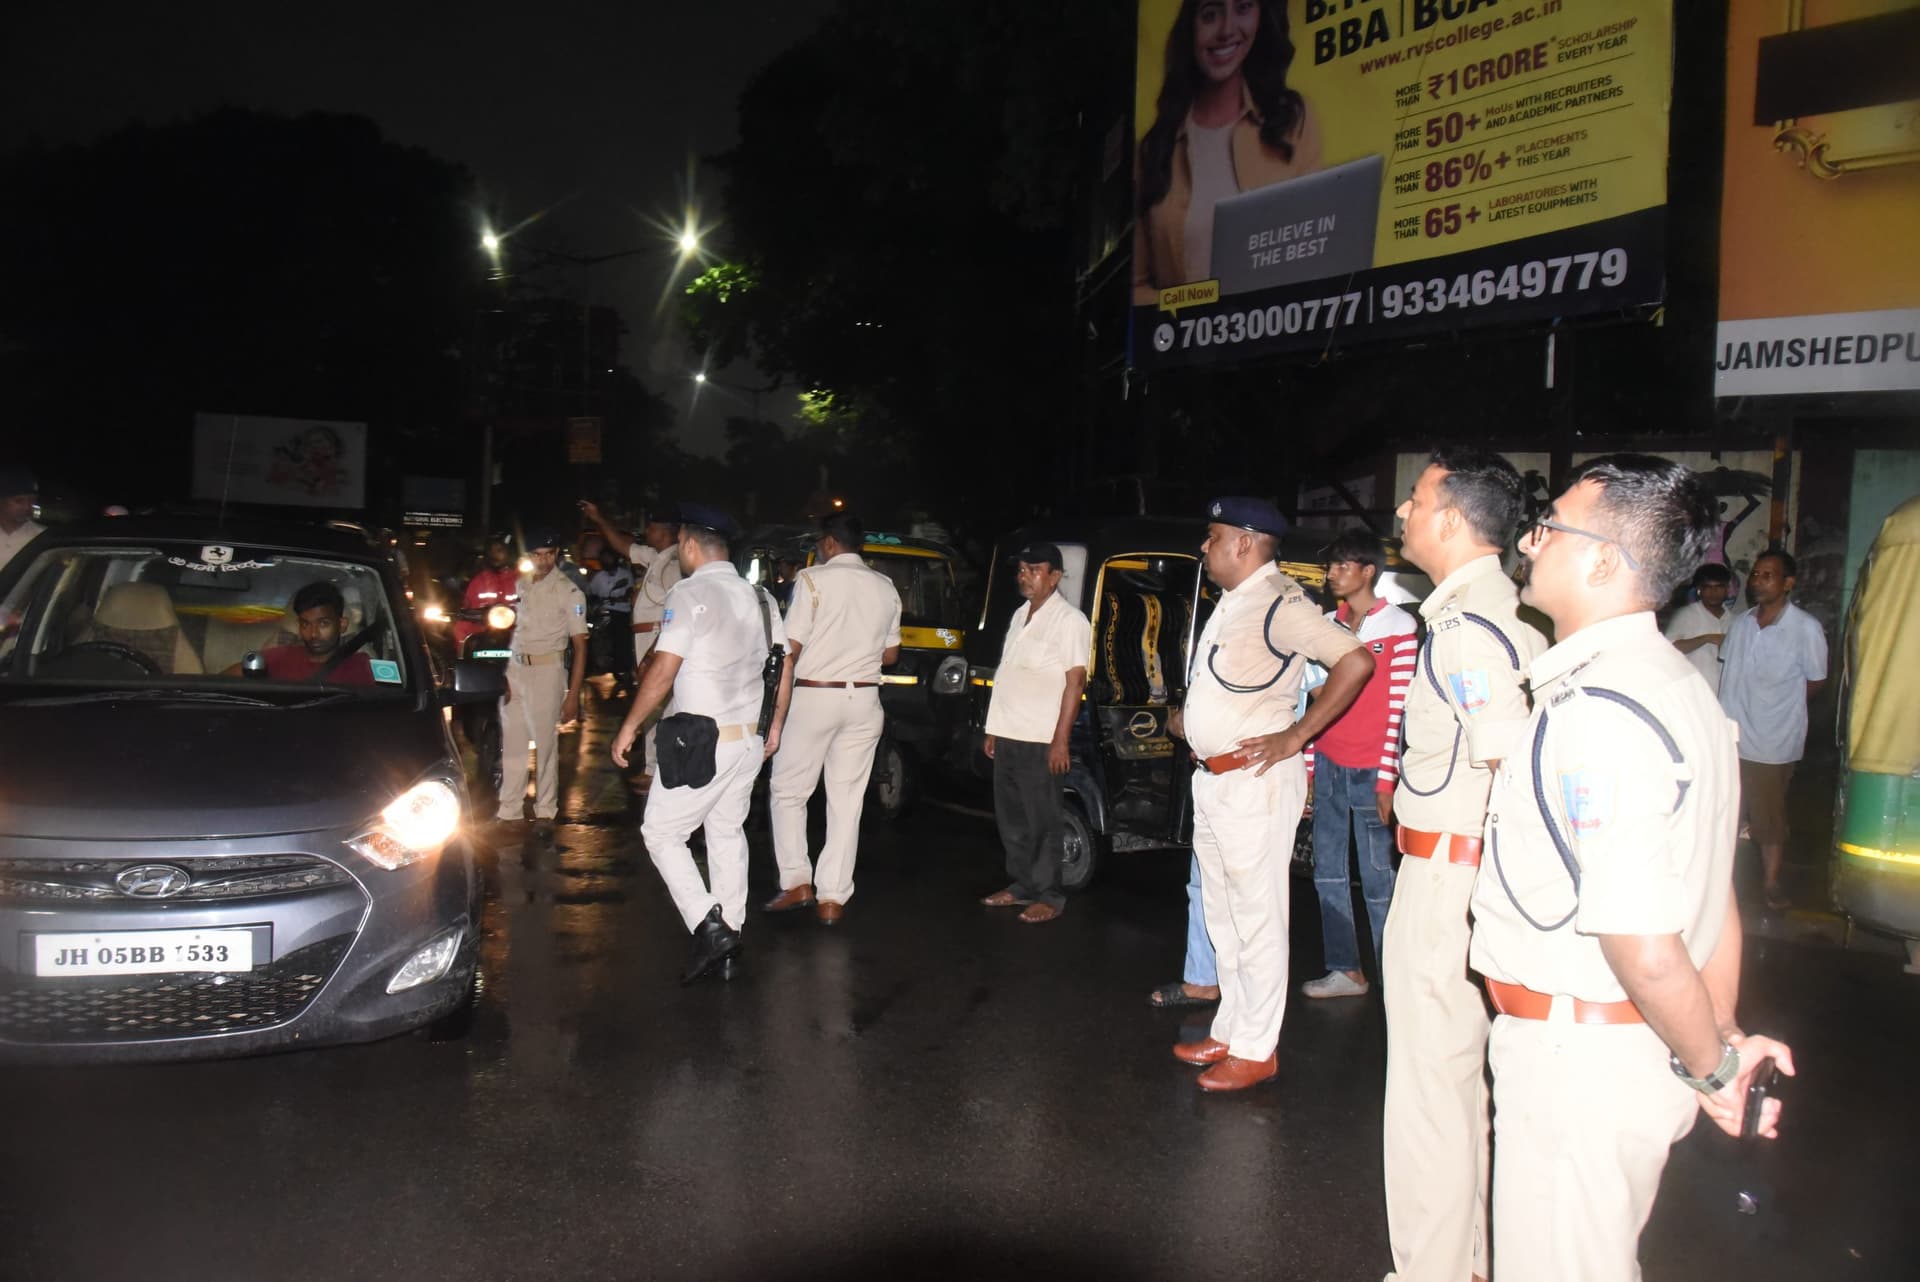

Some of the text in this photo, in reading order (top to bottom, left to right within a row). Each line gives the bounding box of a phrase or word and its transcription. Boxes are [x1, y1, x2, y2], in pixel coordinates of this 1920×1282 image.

[1314, 8, 1390, 65] BBA
[1360, 0, 1563, 74] www.rvscollege.ac.in
[1558, 17, 1638, 49] SCHOLARSHIP
[1557, 34, 1629, 63] EVERY YEAR
[1395, 82, 1421, 98] MORE
[1396, 94, 1420, 108] THAN
[1515, 93, 1543, 110] WITH
[1543, 75, 1613, 102] RECRUITERS
[1485, 86, 1625, 130] AND ACADEMIC PARTNERS
[1395, 127, 1421, 142] MORE
[1396, 138, 1419, 152] THAN
[1515, 129, 1588, 155] PLACEMENTS
[1516, 146, 1571, 168] THIS YEAR
[1394, 170, 1421, 185] MORE
[1395, 181, 1419, 196] THAN
[1488, 178, 1598, 210] LABORATORIES WITH
[1488, 192, 1599, 223] LATEST EQUIPMENTS
[1248, 214, 1337, 251] BELIEVE IN
[1394, 215, 1421, 230] MORE
[1394, 227, 1418, 241] THAN
[1251, 236, 1329, 270] THE BEST
[1163, 285, 1215, 306] Call Now
[1179, 247, 1628, 349] 7033000777 9334649779
[55, 948, 88, 966] JH
[97, 946, 165, 965] 05BB
